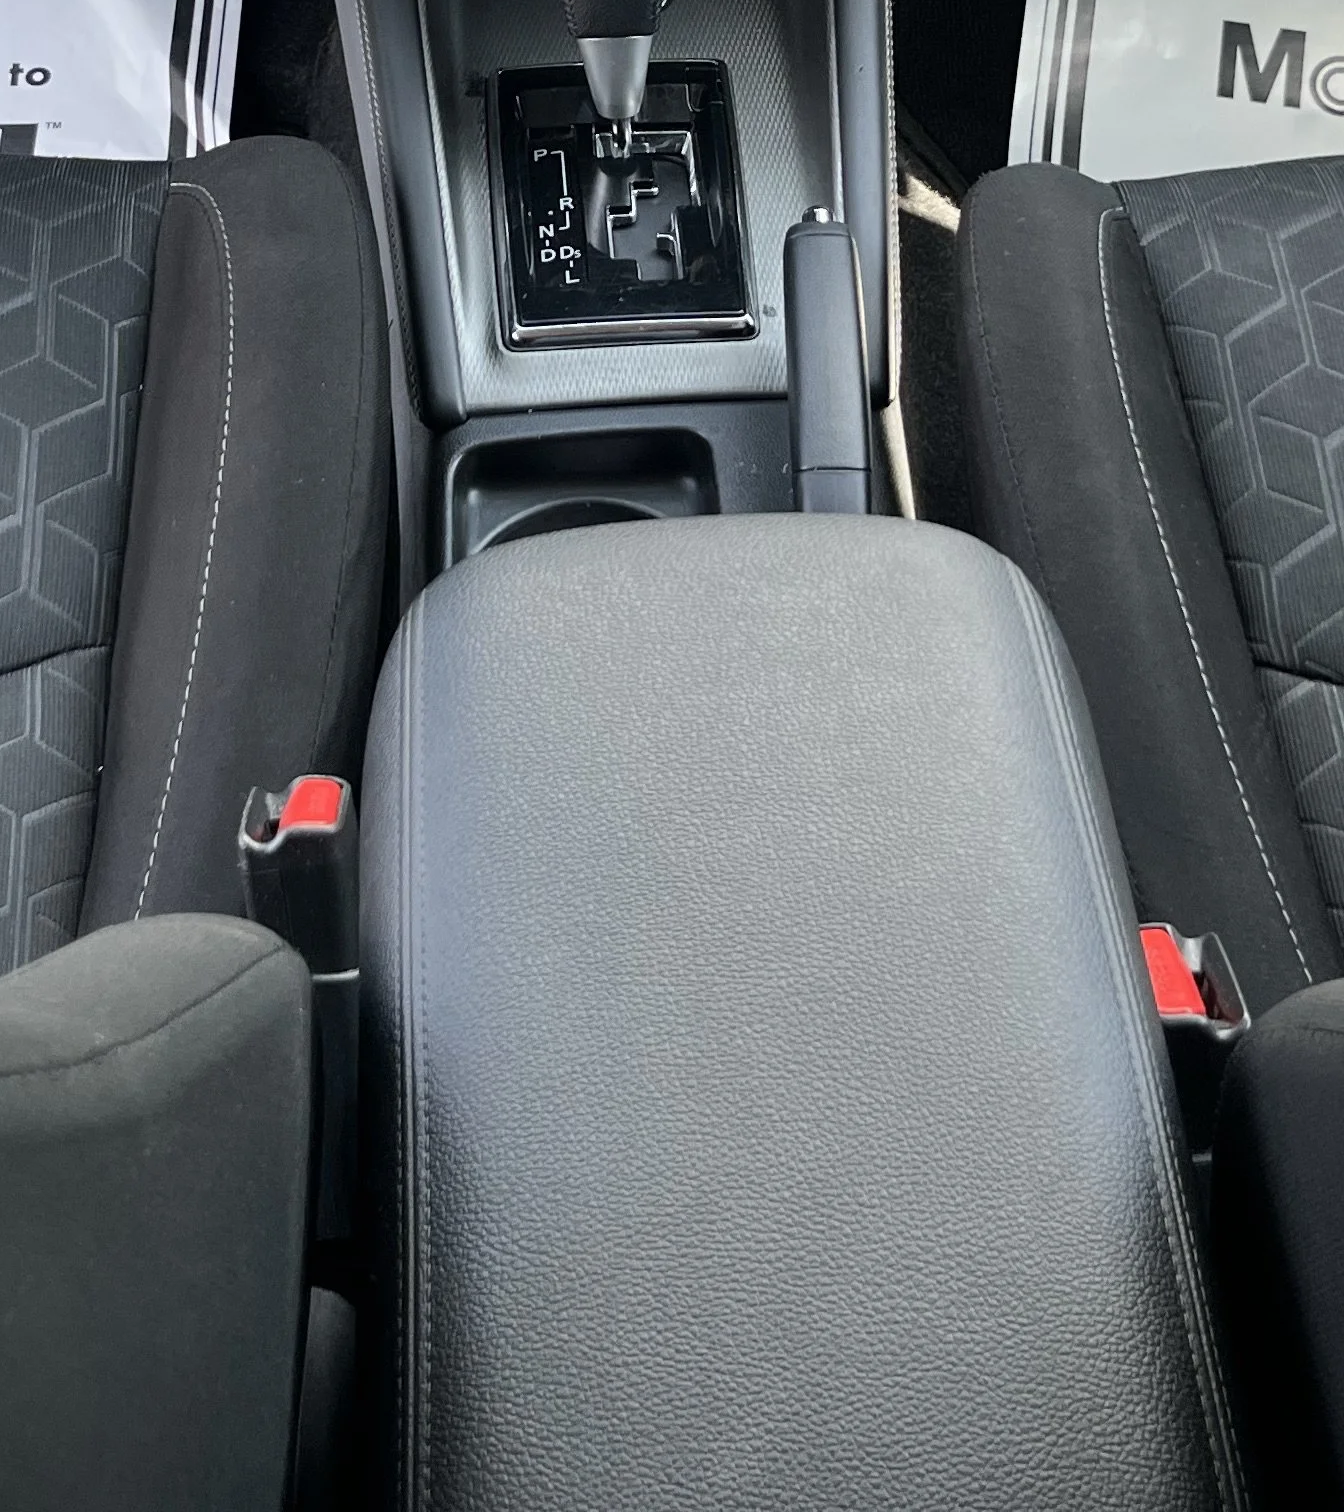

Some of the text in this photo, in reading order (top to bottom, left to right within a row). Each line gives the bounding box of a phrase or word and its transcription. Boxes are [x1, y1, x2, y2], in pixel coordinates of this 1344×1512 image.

[8, 61, 52, 87] to
[533, 149, 548, 162] P
[559, 197, 575, 211] R
[539, 223, 555, 238] N
[541, 248, 557, 262] D
[565, 270, 581, 284] L
